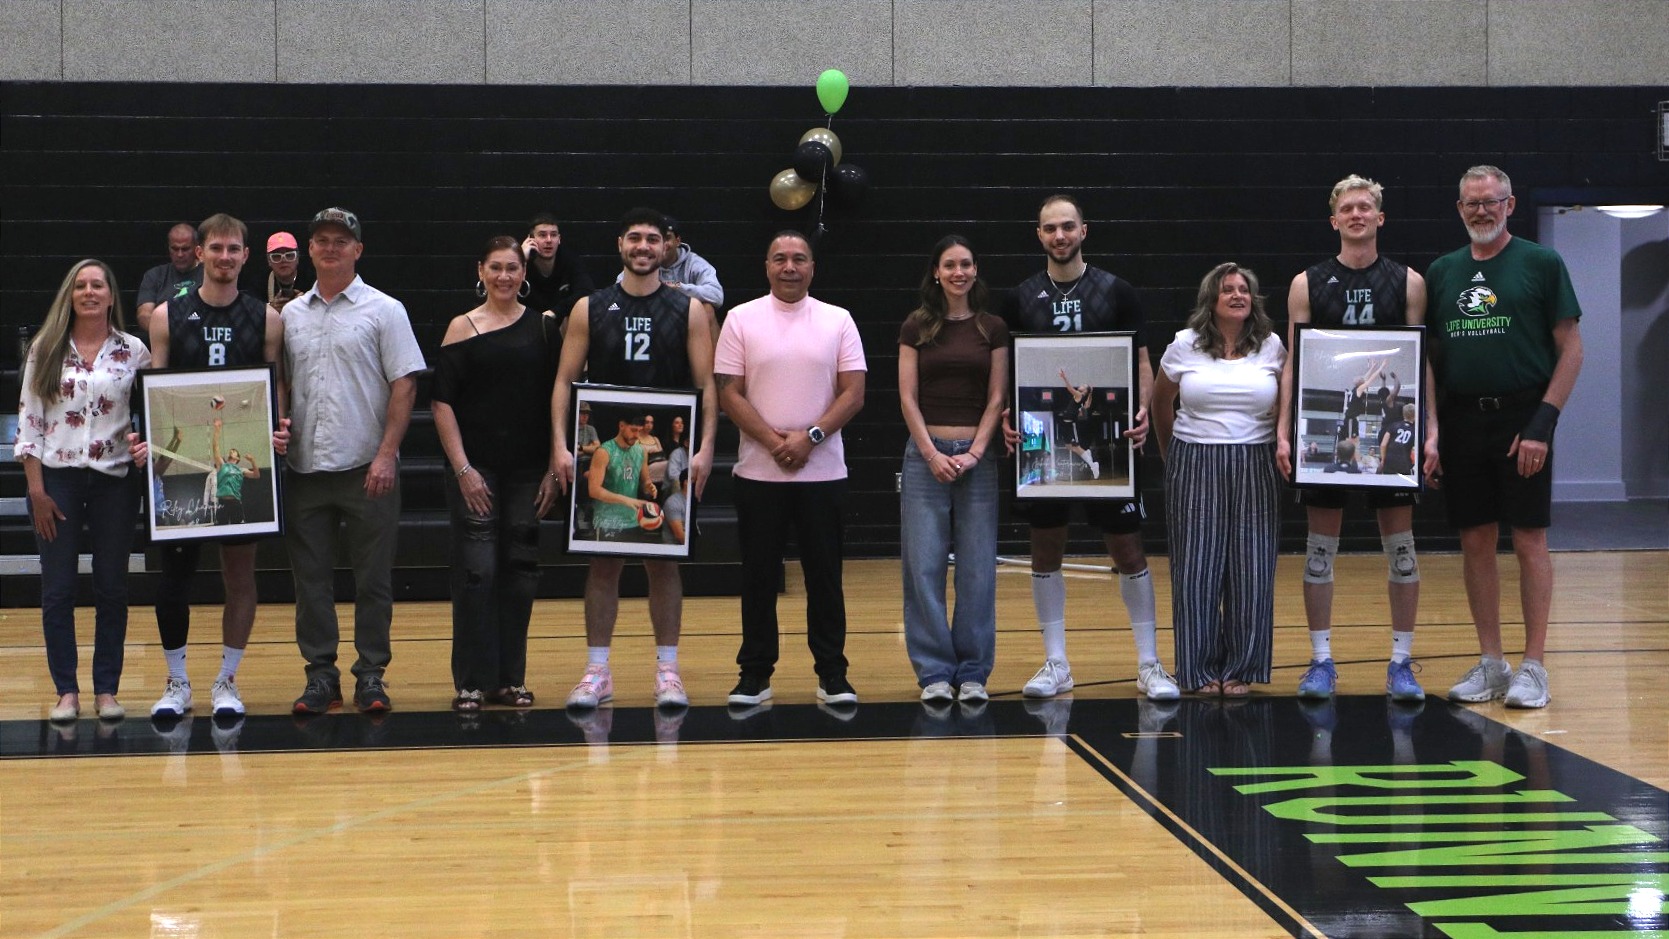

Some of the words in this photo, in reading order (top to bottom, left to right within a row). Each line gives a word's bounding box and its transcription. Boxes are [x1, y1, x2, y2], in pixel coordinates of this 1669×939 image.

[1346, 288, 1372, 303] LIFE
[1053, 299, 1081, 315] LIFE
[1342, 304, 1376, 325] 44
[624, 317, 651, 331] LIFE
[1446, 319, 1461, 332] LIFE
[1462, 315, 1511, 330] UNIVERSITY
[203, 327, 232, 341] LIFE
[1468, 328, 1505, 336] VOLLEYBALL
[208, 342, 225, 366] 8
[624, 332, 651, 361] 12
[1395, 429, 1411, 443] 20
[623, 467, 633, 480] 12
[1206, 760, 1669, 939] RUNN
